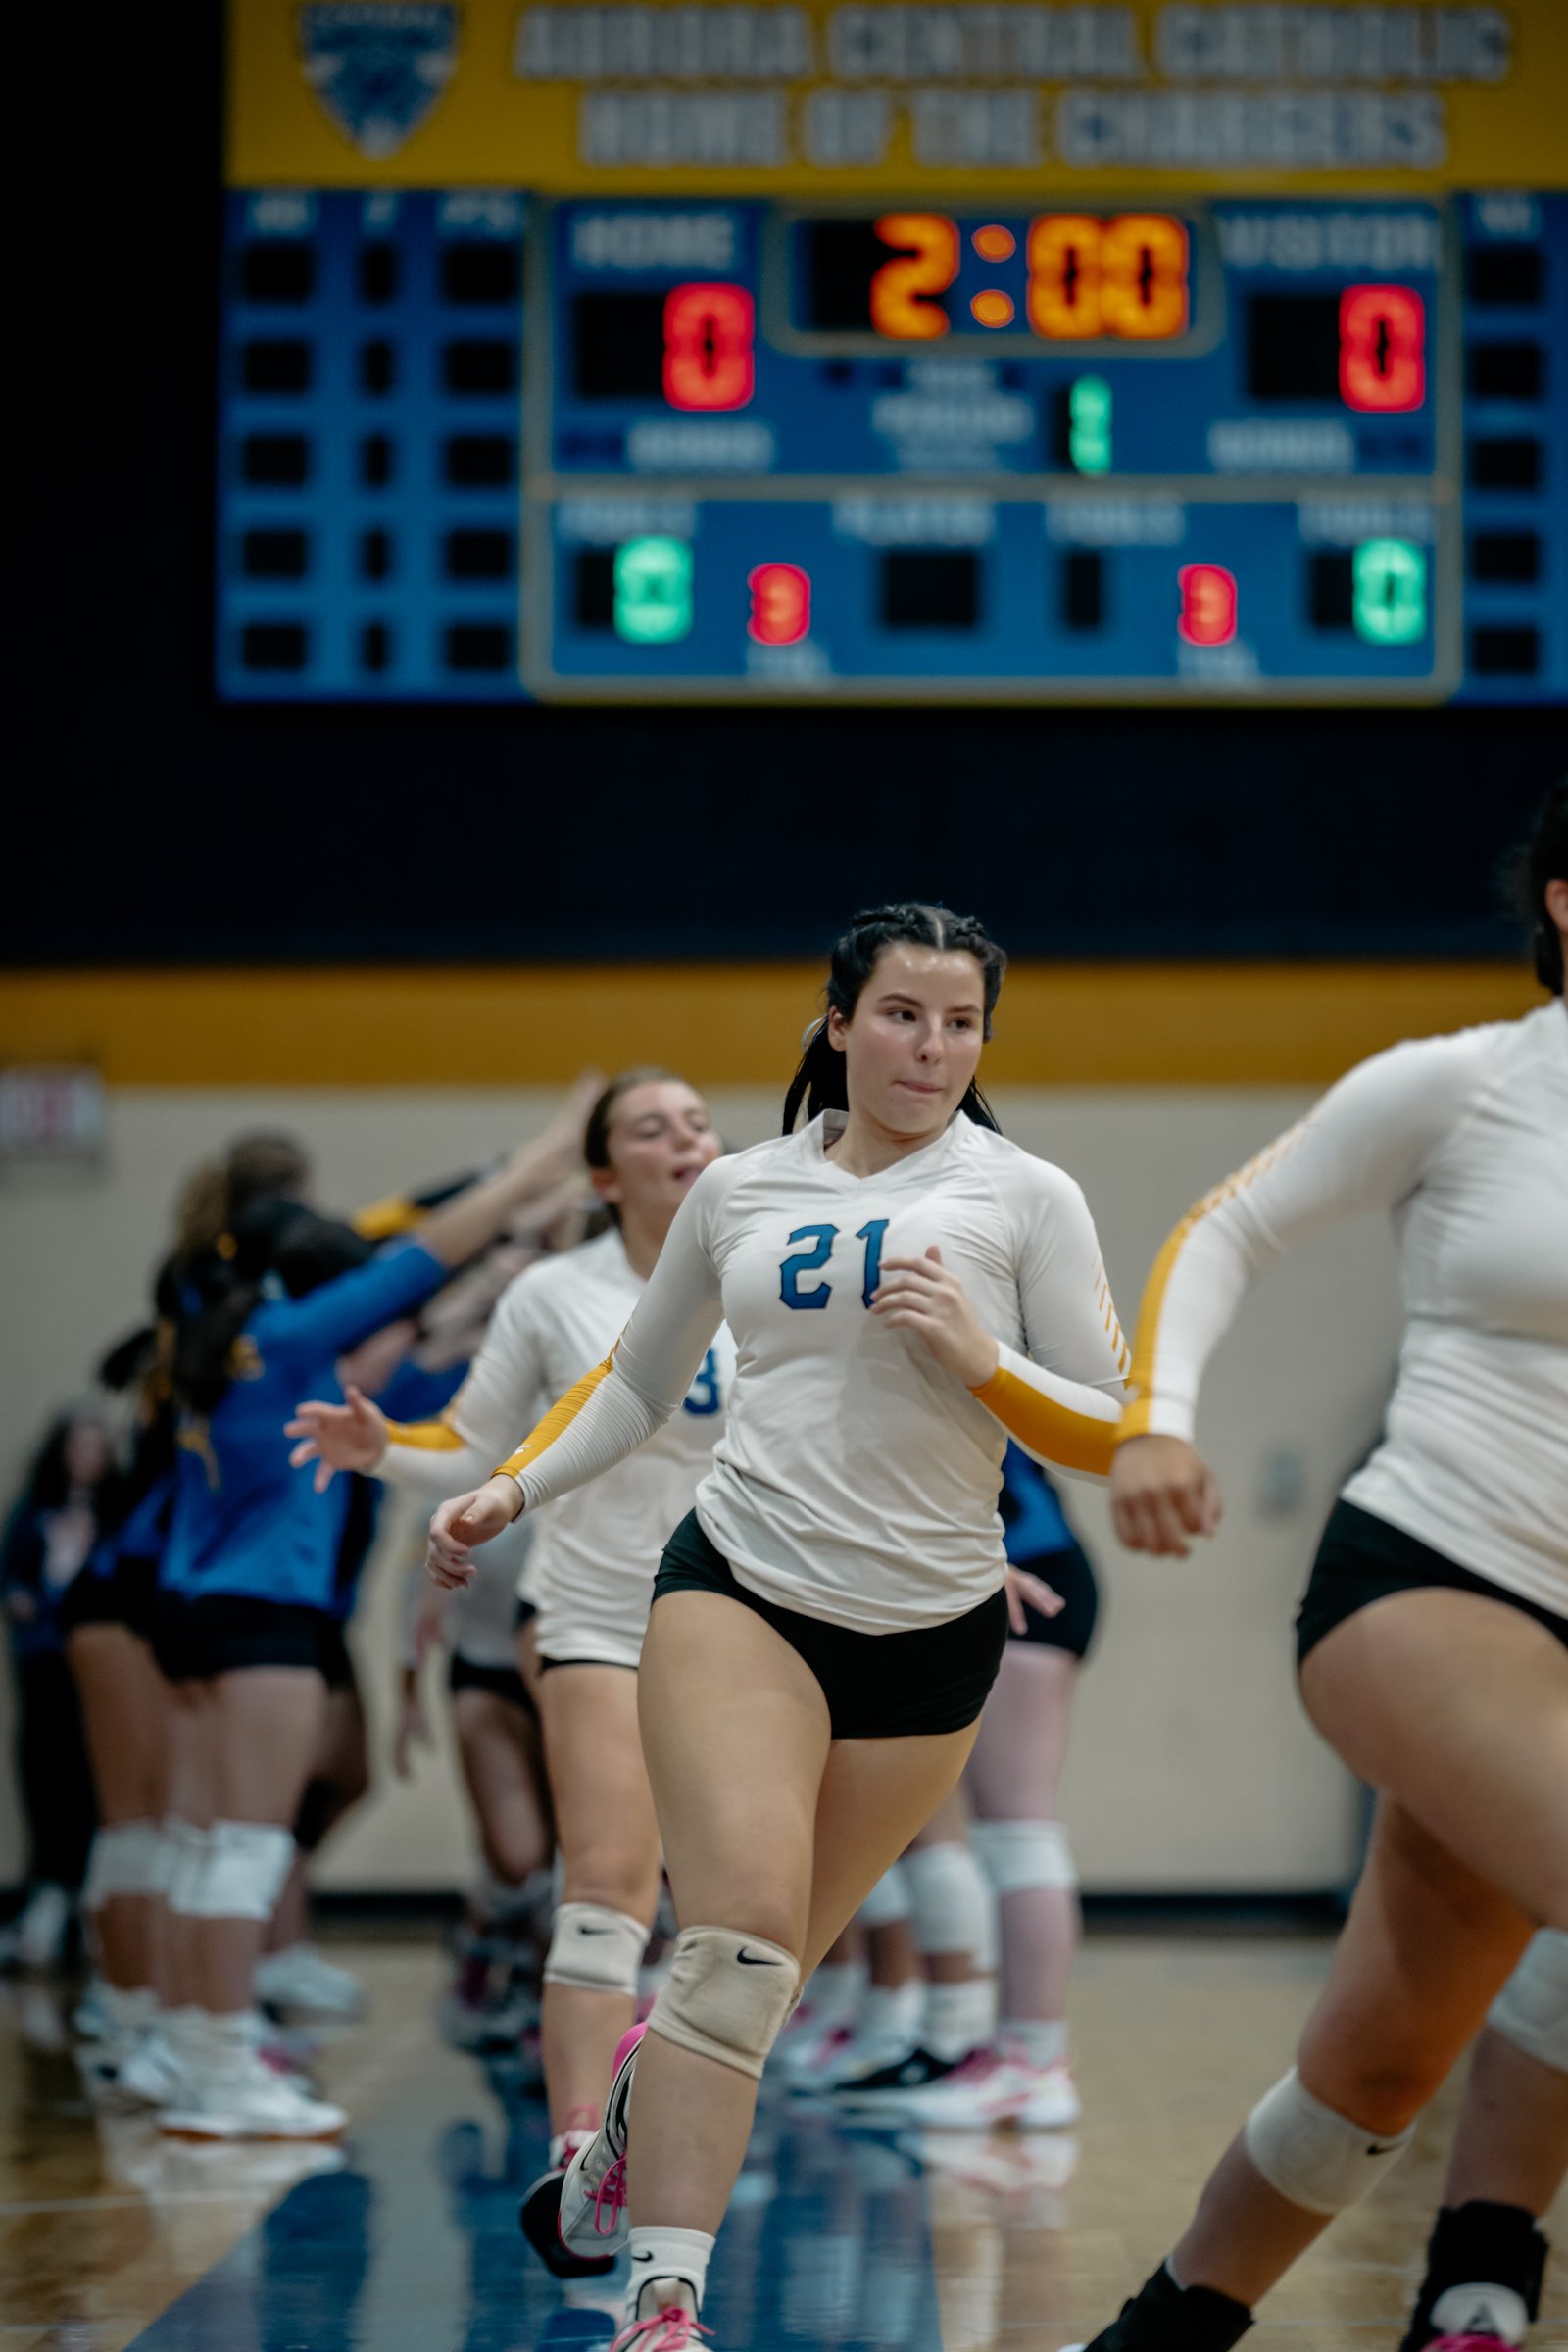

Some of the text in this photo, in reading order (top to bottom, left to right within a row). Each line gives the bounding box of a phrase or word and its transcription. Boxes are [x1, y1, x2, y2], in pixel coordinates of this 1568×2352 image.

[515, 4, 1510, 81] AURORA CENTRAL CATHOLIC
[579, 89, 1447, 169] HOME OF THE CHARGERS
[574, 214, 735, 269] HOME
[870, 212, 1190, 341] 2:00
[1219, 214, 1440, 269] VISITOR
[663, 282, 755, 412] 0
[1339, 284, 1426, 413] 0
[779, 1219, 890, 1310] 21
